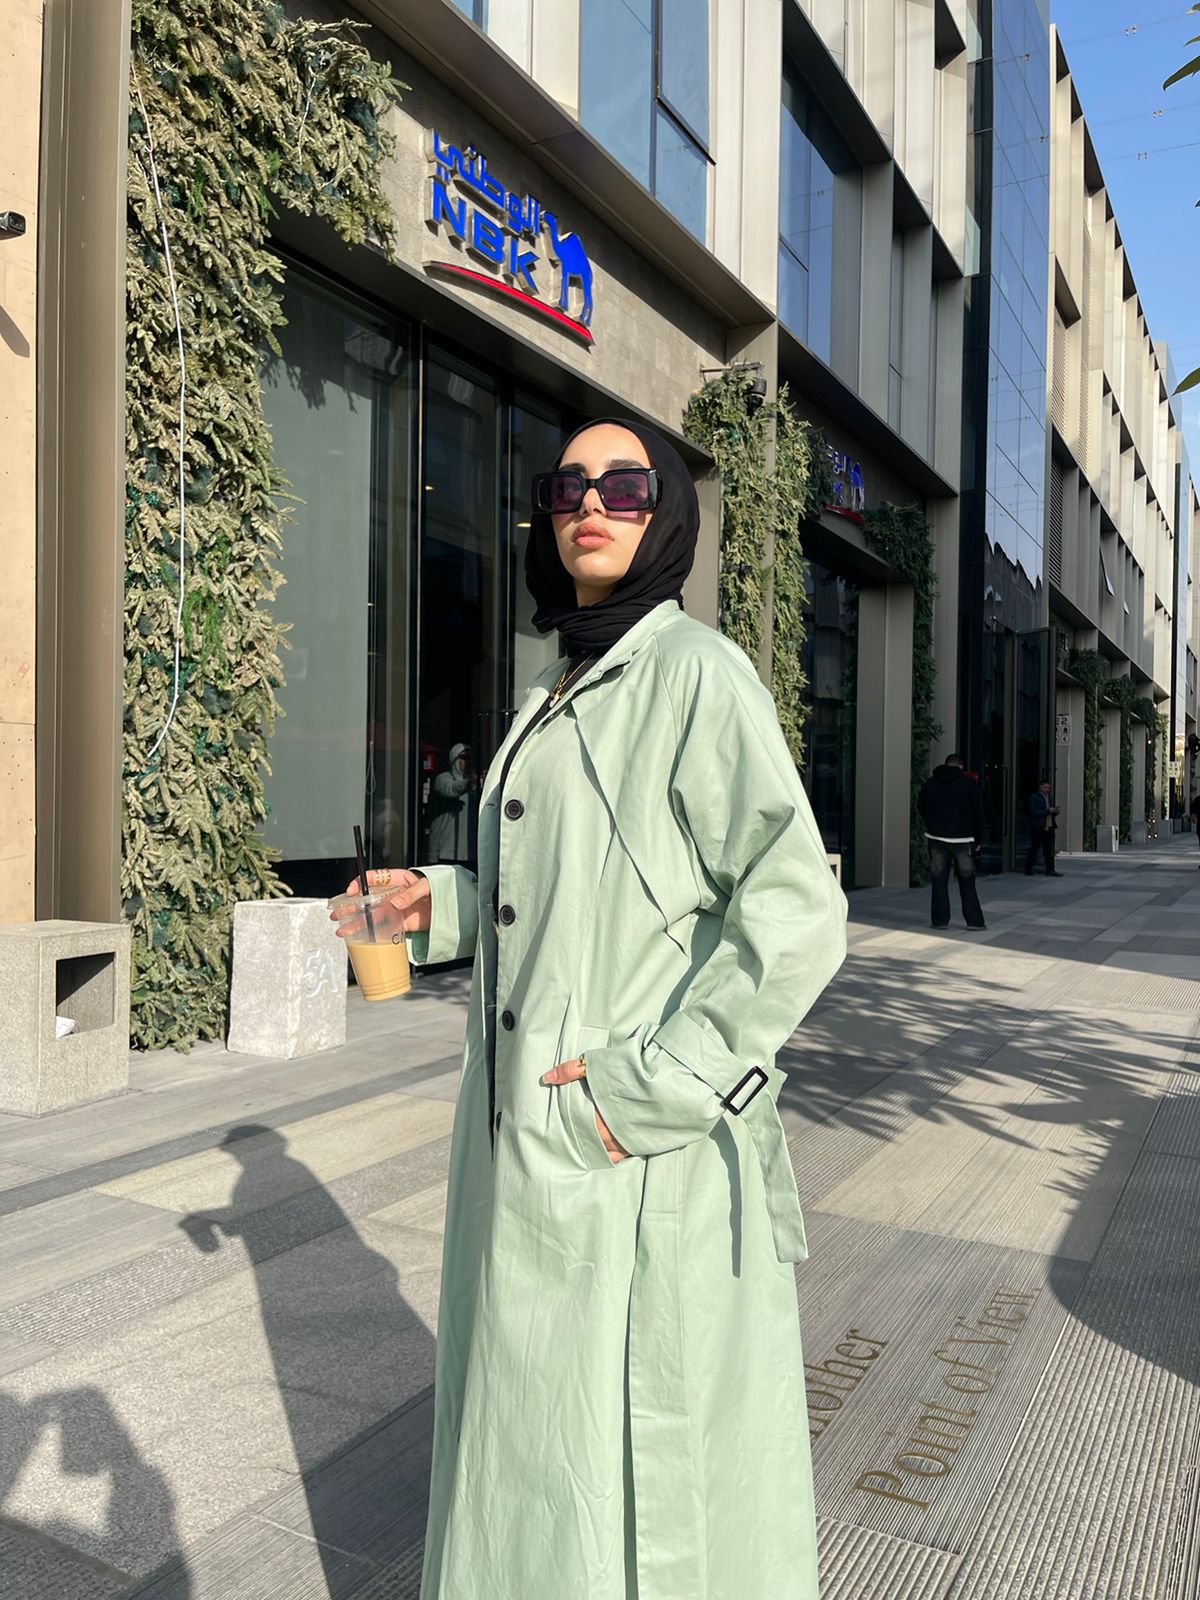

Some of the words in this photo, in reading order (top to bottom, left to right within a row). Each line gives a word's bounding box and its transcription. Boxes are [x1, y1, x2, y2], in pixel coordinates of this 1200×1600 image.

[432, 129, 541, 238] الوطني
[432, 176, 540, 295] NBK
[854, 1398, 978, 1512] Point
[932, 1349, 999, 1394] of
